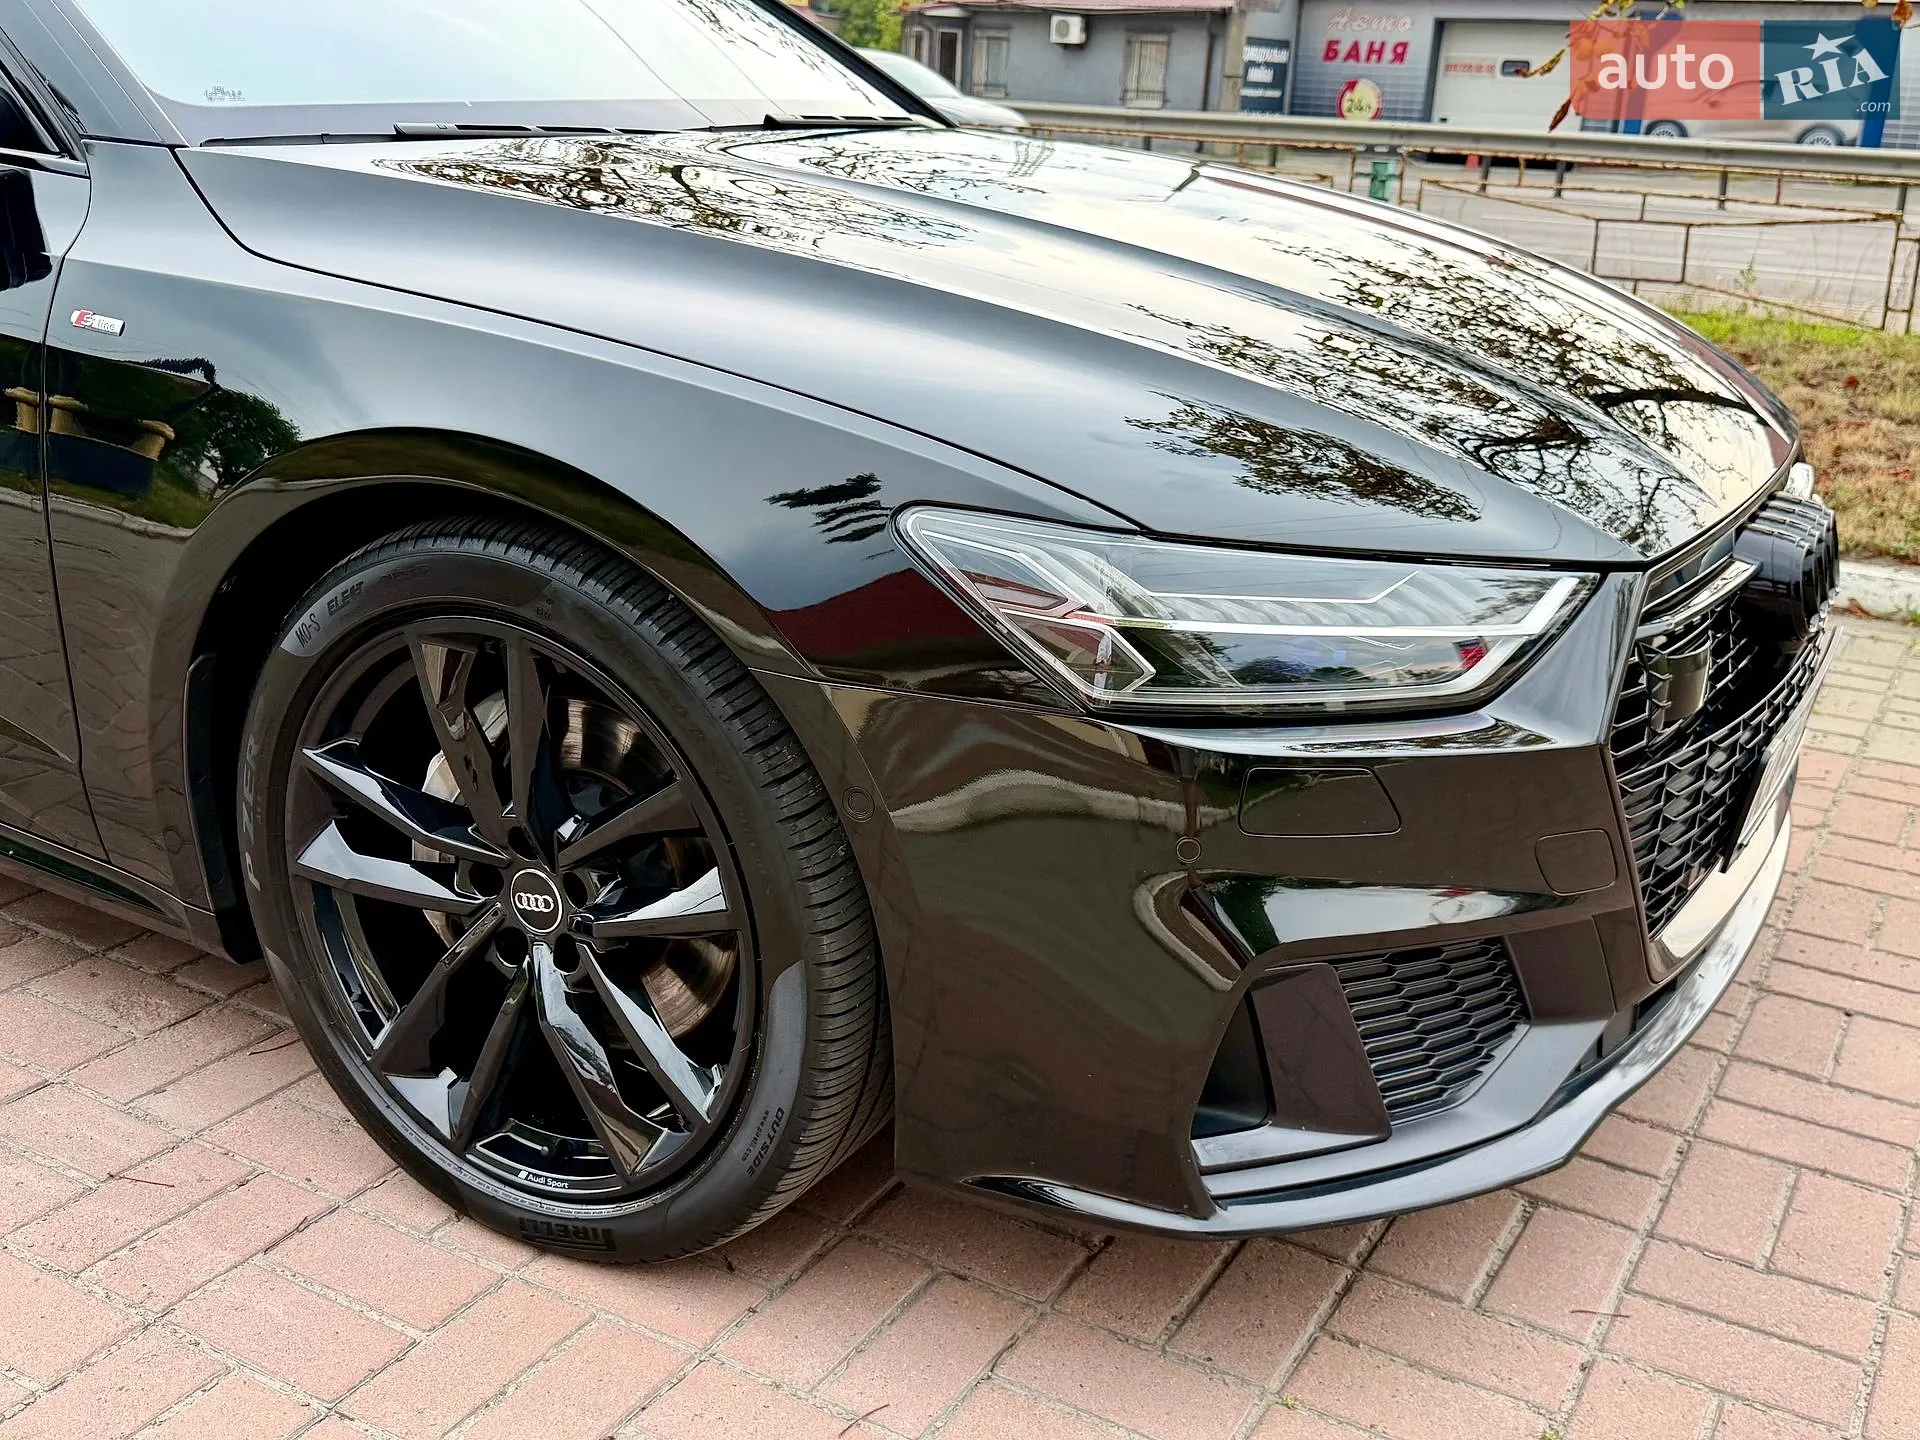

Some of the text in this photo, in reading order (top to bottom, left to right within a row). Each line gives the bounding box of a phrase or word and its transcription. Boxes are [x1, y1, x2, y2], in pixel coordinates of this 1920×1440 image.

[1322, 40, 1409, 64] БАНЯ
[97, 318, 115, 331] line
[294, 612, 322, 648] MO-S
[245, 852, 261, 892] P
[745, 1106, 785, 1178] OUTSIDE
[527, 1174, 569, 1189] Audi Sport
[518, 1217, 619, 1253] PIRELLI
